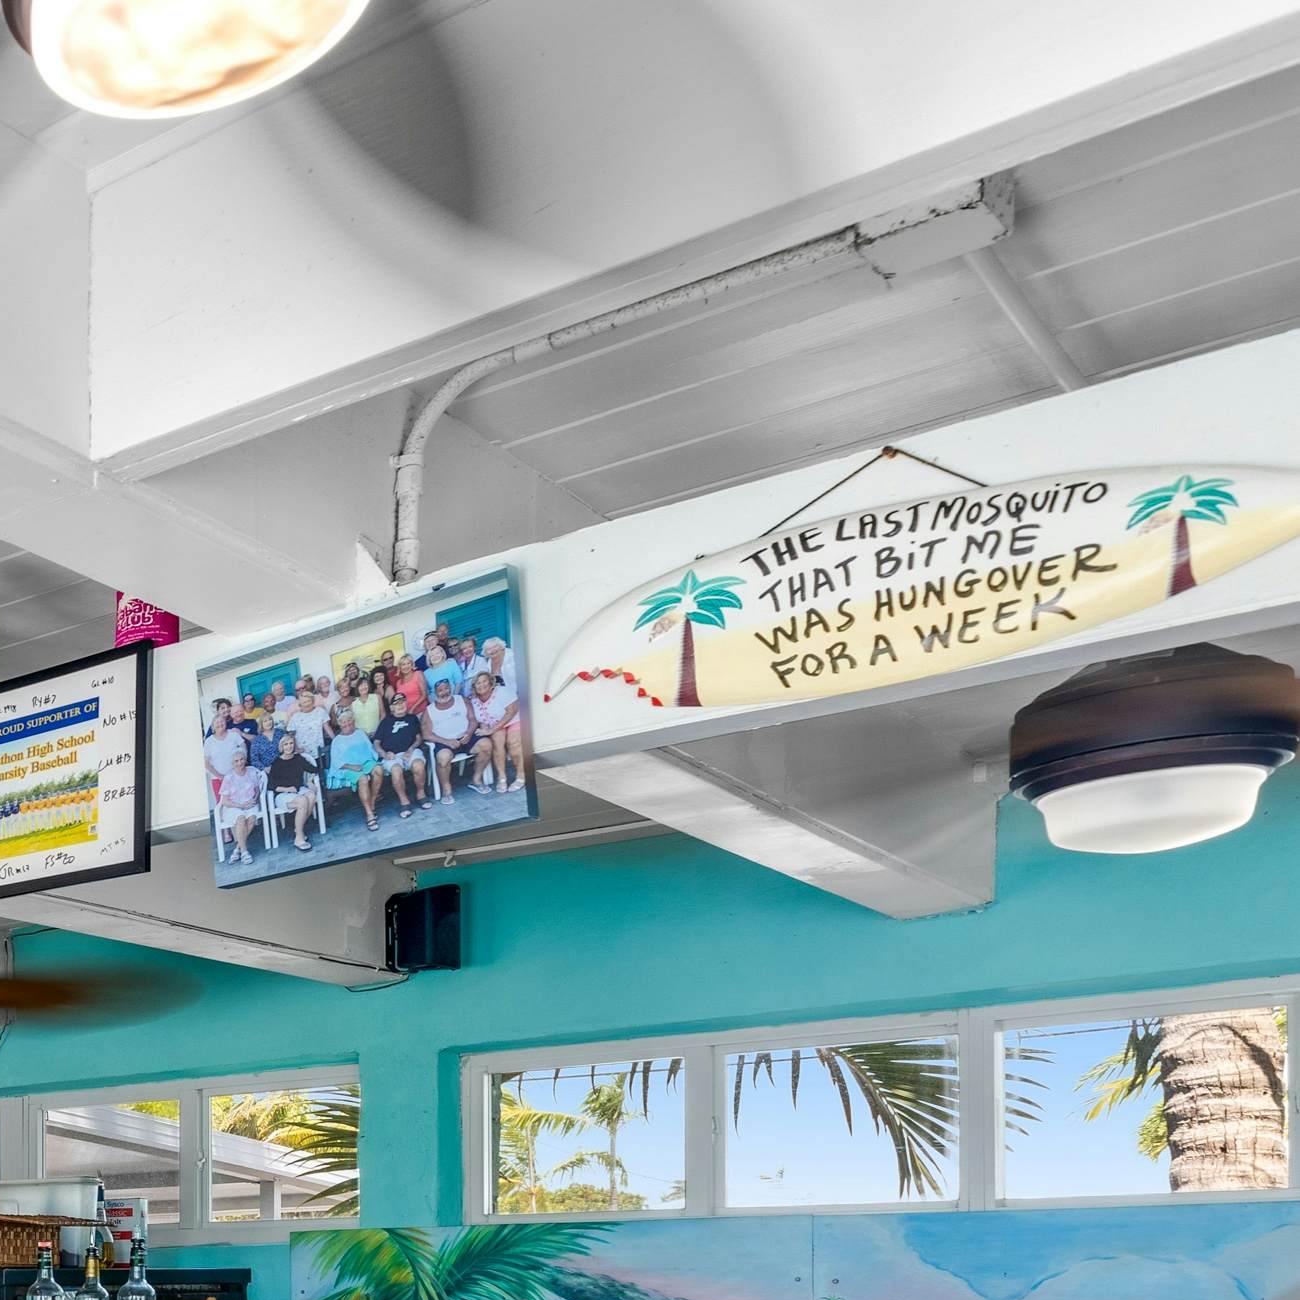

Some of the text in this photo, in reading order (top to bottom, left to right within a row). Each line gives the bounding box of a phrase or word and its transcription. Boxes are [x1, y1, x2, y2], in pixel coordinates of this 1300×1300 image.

[740, 527, 825, 577] THE
[836, 500, 929, 541] LAST
[759, 555, 857, 612] THAT
[961, 524, 1041, 563] ME
[754, 544, 1118, 655] WAS HUNGOVER
[770, 587, 1078, 689] FOR A WEEK
[26, 708, 81, 731] SUPPORTER
[83, 702, 98, 714] OF
[27, 743, 54, 762] High
[56, 731, 95, 752] School
[30, 752, 78, 774] Baseball
